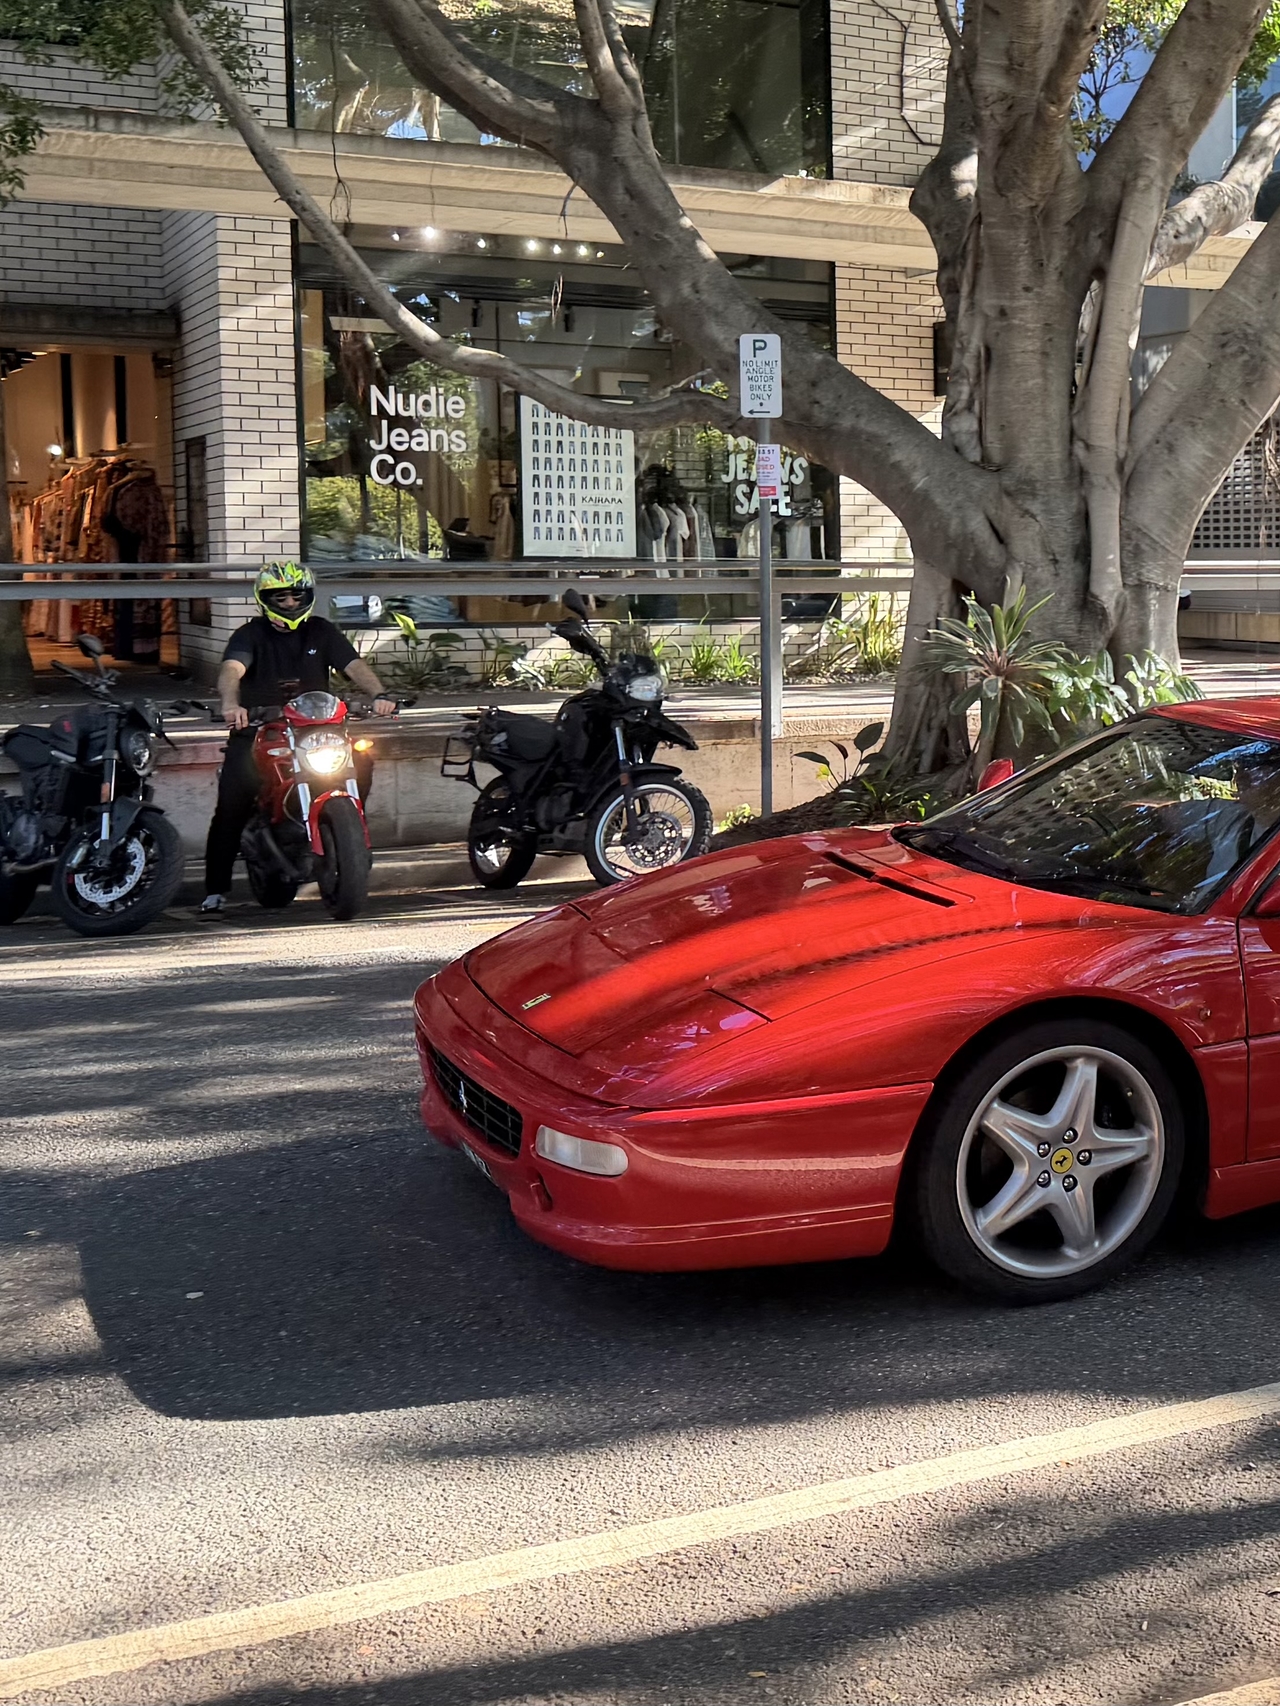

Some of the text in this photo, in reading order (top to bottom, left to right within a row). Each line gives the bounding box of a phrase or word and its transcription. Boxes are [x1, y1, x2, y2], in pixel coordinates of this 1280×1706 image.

[753, 339, 767, 358] P
[750, 384, 773, 392] BIKES
[750, 393, 772, 401] ONLY
[370, 384, 466, 419] Nudie
[369, 419, 467, 453] Jeans
[370, 453, 423, 485] Co.
[581, 495, 623, 505] KAIHARA
